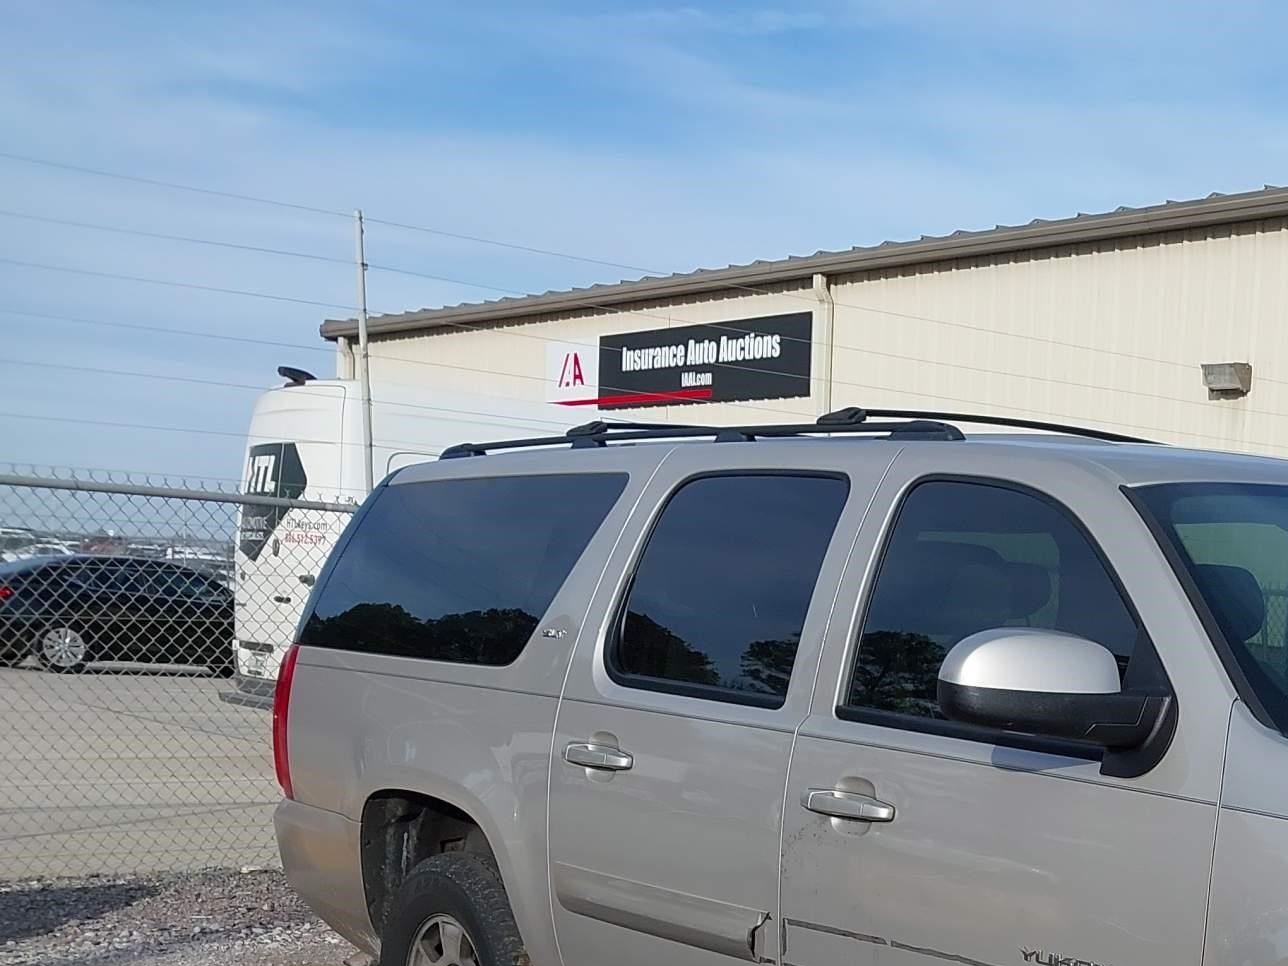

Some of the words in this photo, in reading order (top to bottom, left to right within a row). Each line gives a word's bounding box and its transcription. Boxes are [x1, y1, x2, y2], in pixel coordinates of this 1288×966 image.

[622, 344, 685, 372] Insurance
[686, 339, 718, 366] Auto
[718, 332, 781, 362] Auctions
